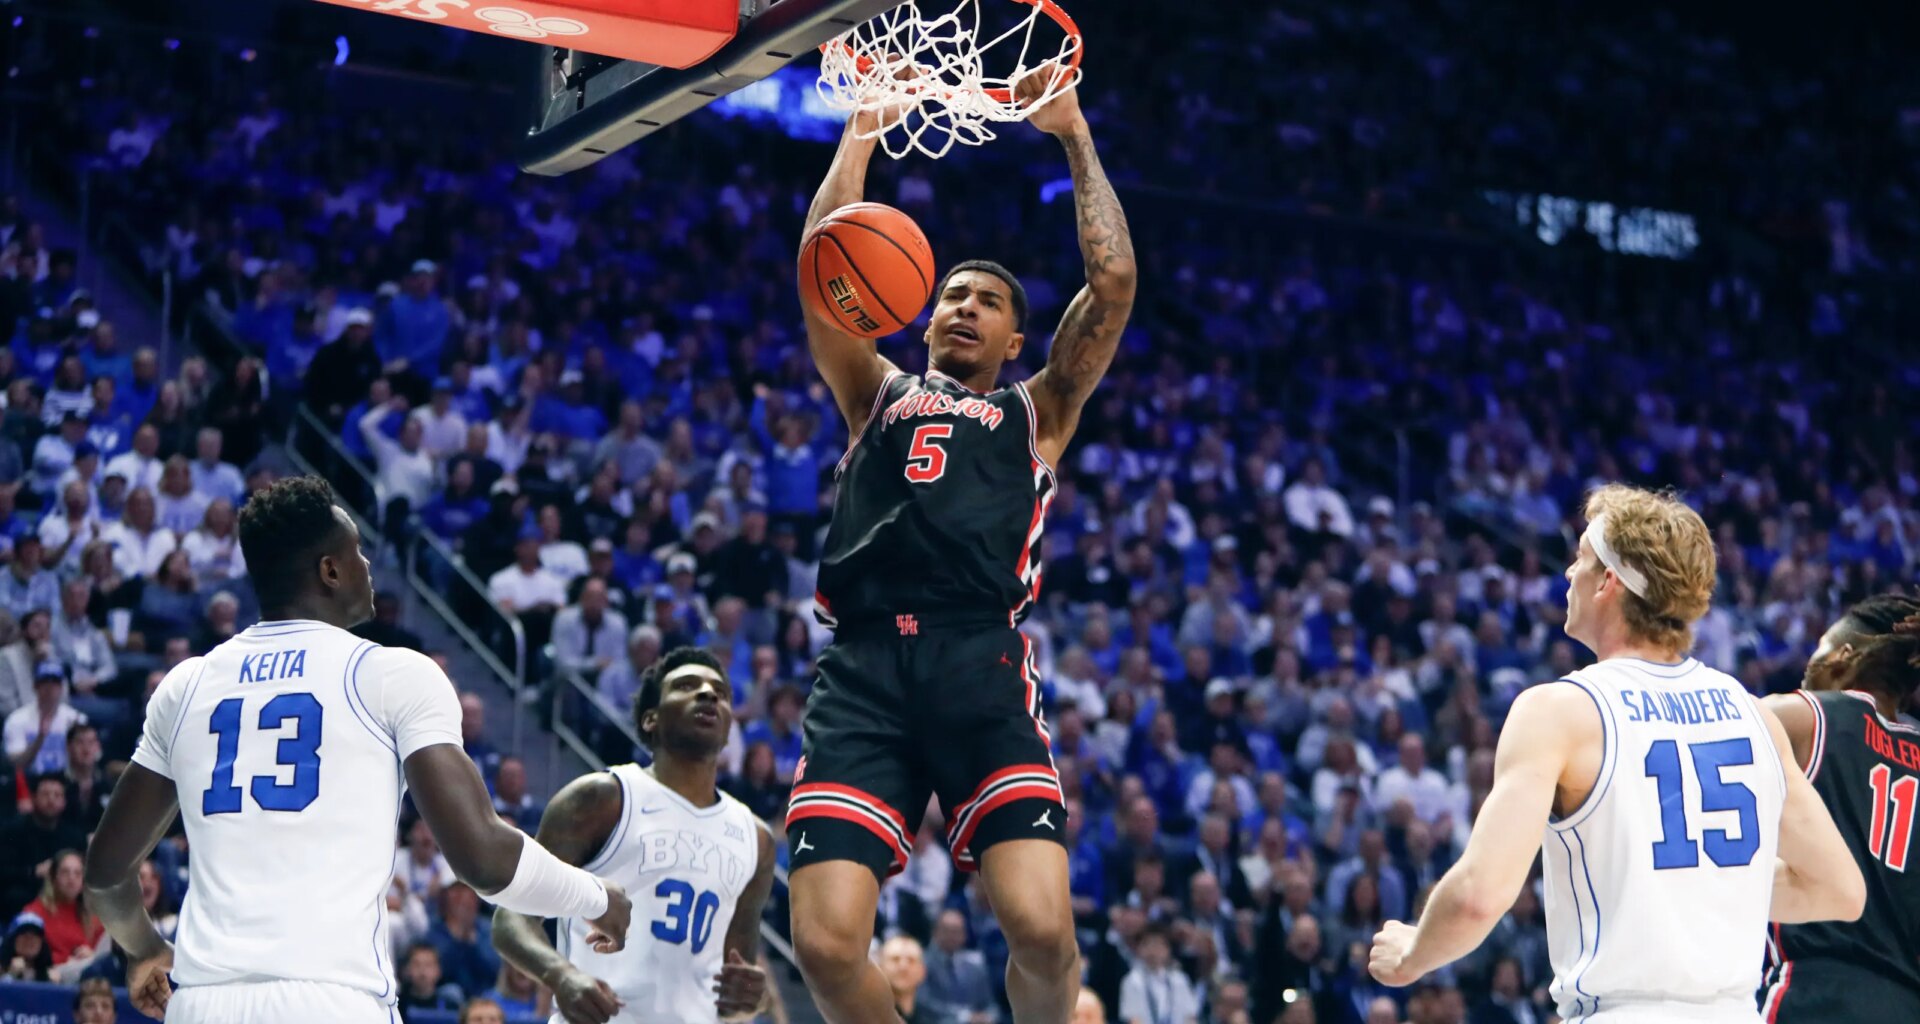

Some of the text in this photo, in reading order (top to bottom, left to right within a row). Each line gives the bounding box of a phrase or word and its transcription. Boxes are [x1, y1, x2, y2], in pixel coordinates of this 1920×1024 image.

[827, 276, 881, 333] ELITE
[881, 385, 1003, 432] Houston
[904, 423, 953, 483] 5
[239, 649, 306, 683] KEITA
[1620, 688, 1742, 725] SAUNDERS
[203, 692, 323, 816] 13
[1644, 737, 1760, 870] 15
[1869, 762, 1919, 873] 11
[638, 829, 746, 899] BYU
[650, 878, 720, 955] 30
